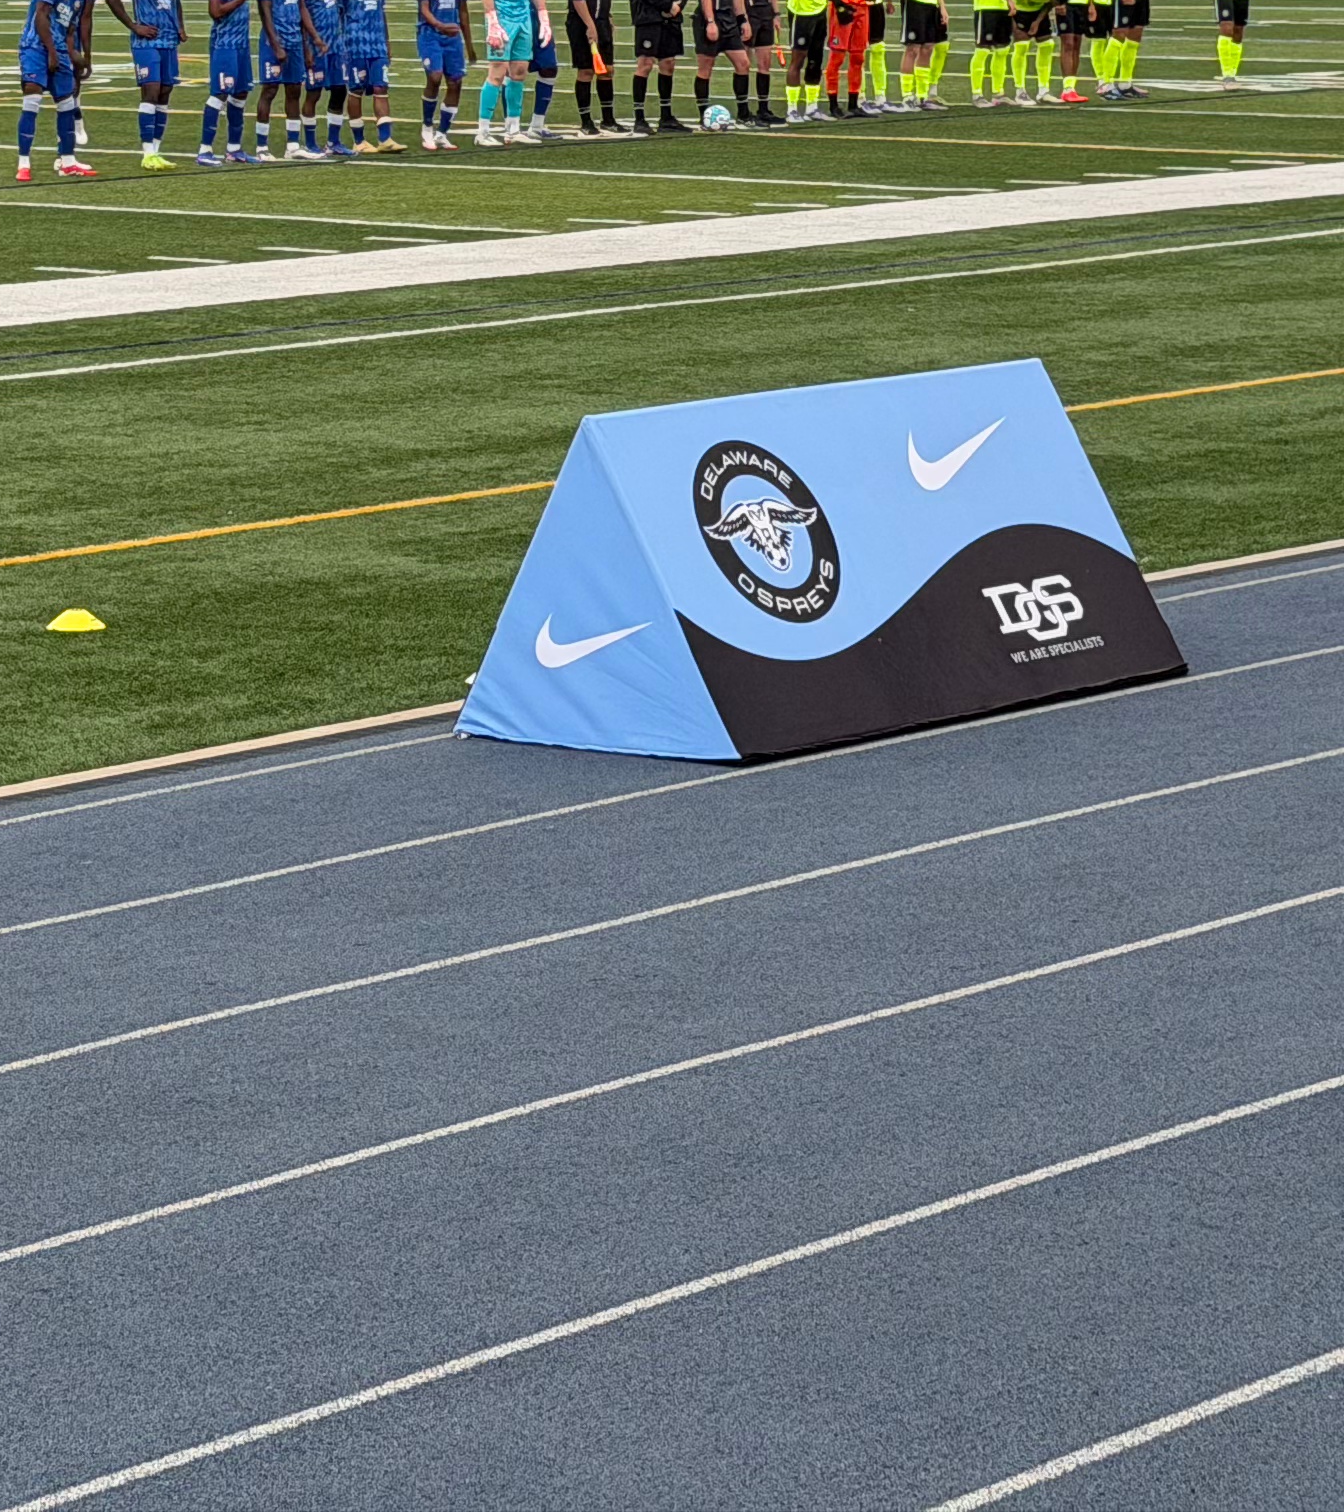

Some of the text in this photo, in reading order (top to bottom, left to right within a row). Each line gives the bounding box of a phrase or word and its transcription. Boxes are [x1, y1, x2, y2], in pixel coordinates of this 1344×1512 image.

[700, 450, 793, 502] DELAWARE
[737, 558, 834, 615] OSPREYS
[1010, 635, 1105, 663] WE ARE SPECIALISTS
